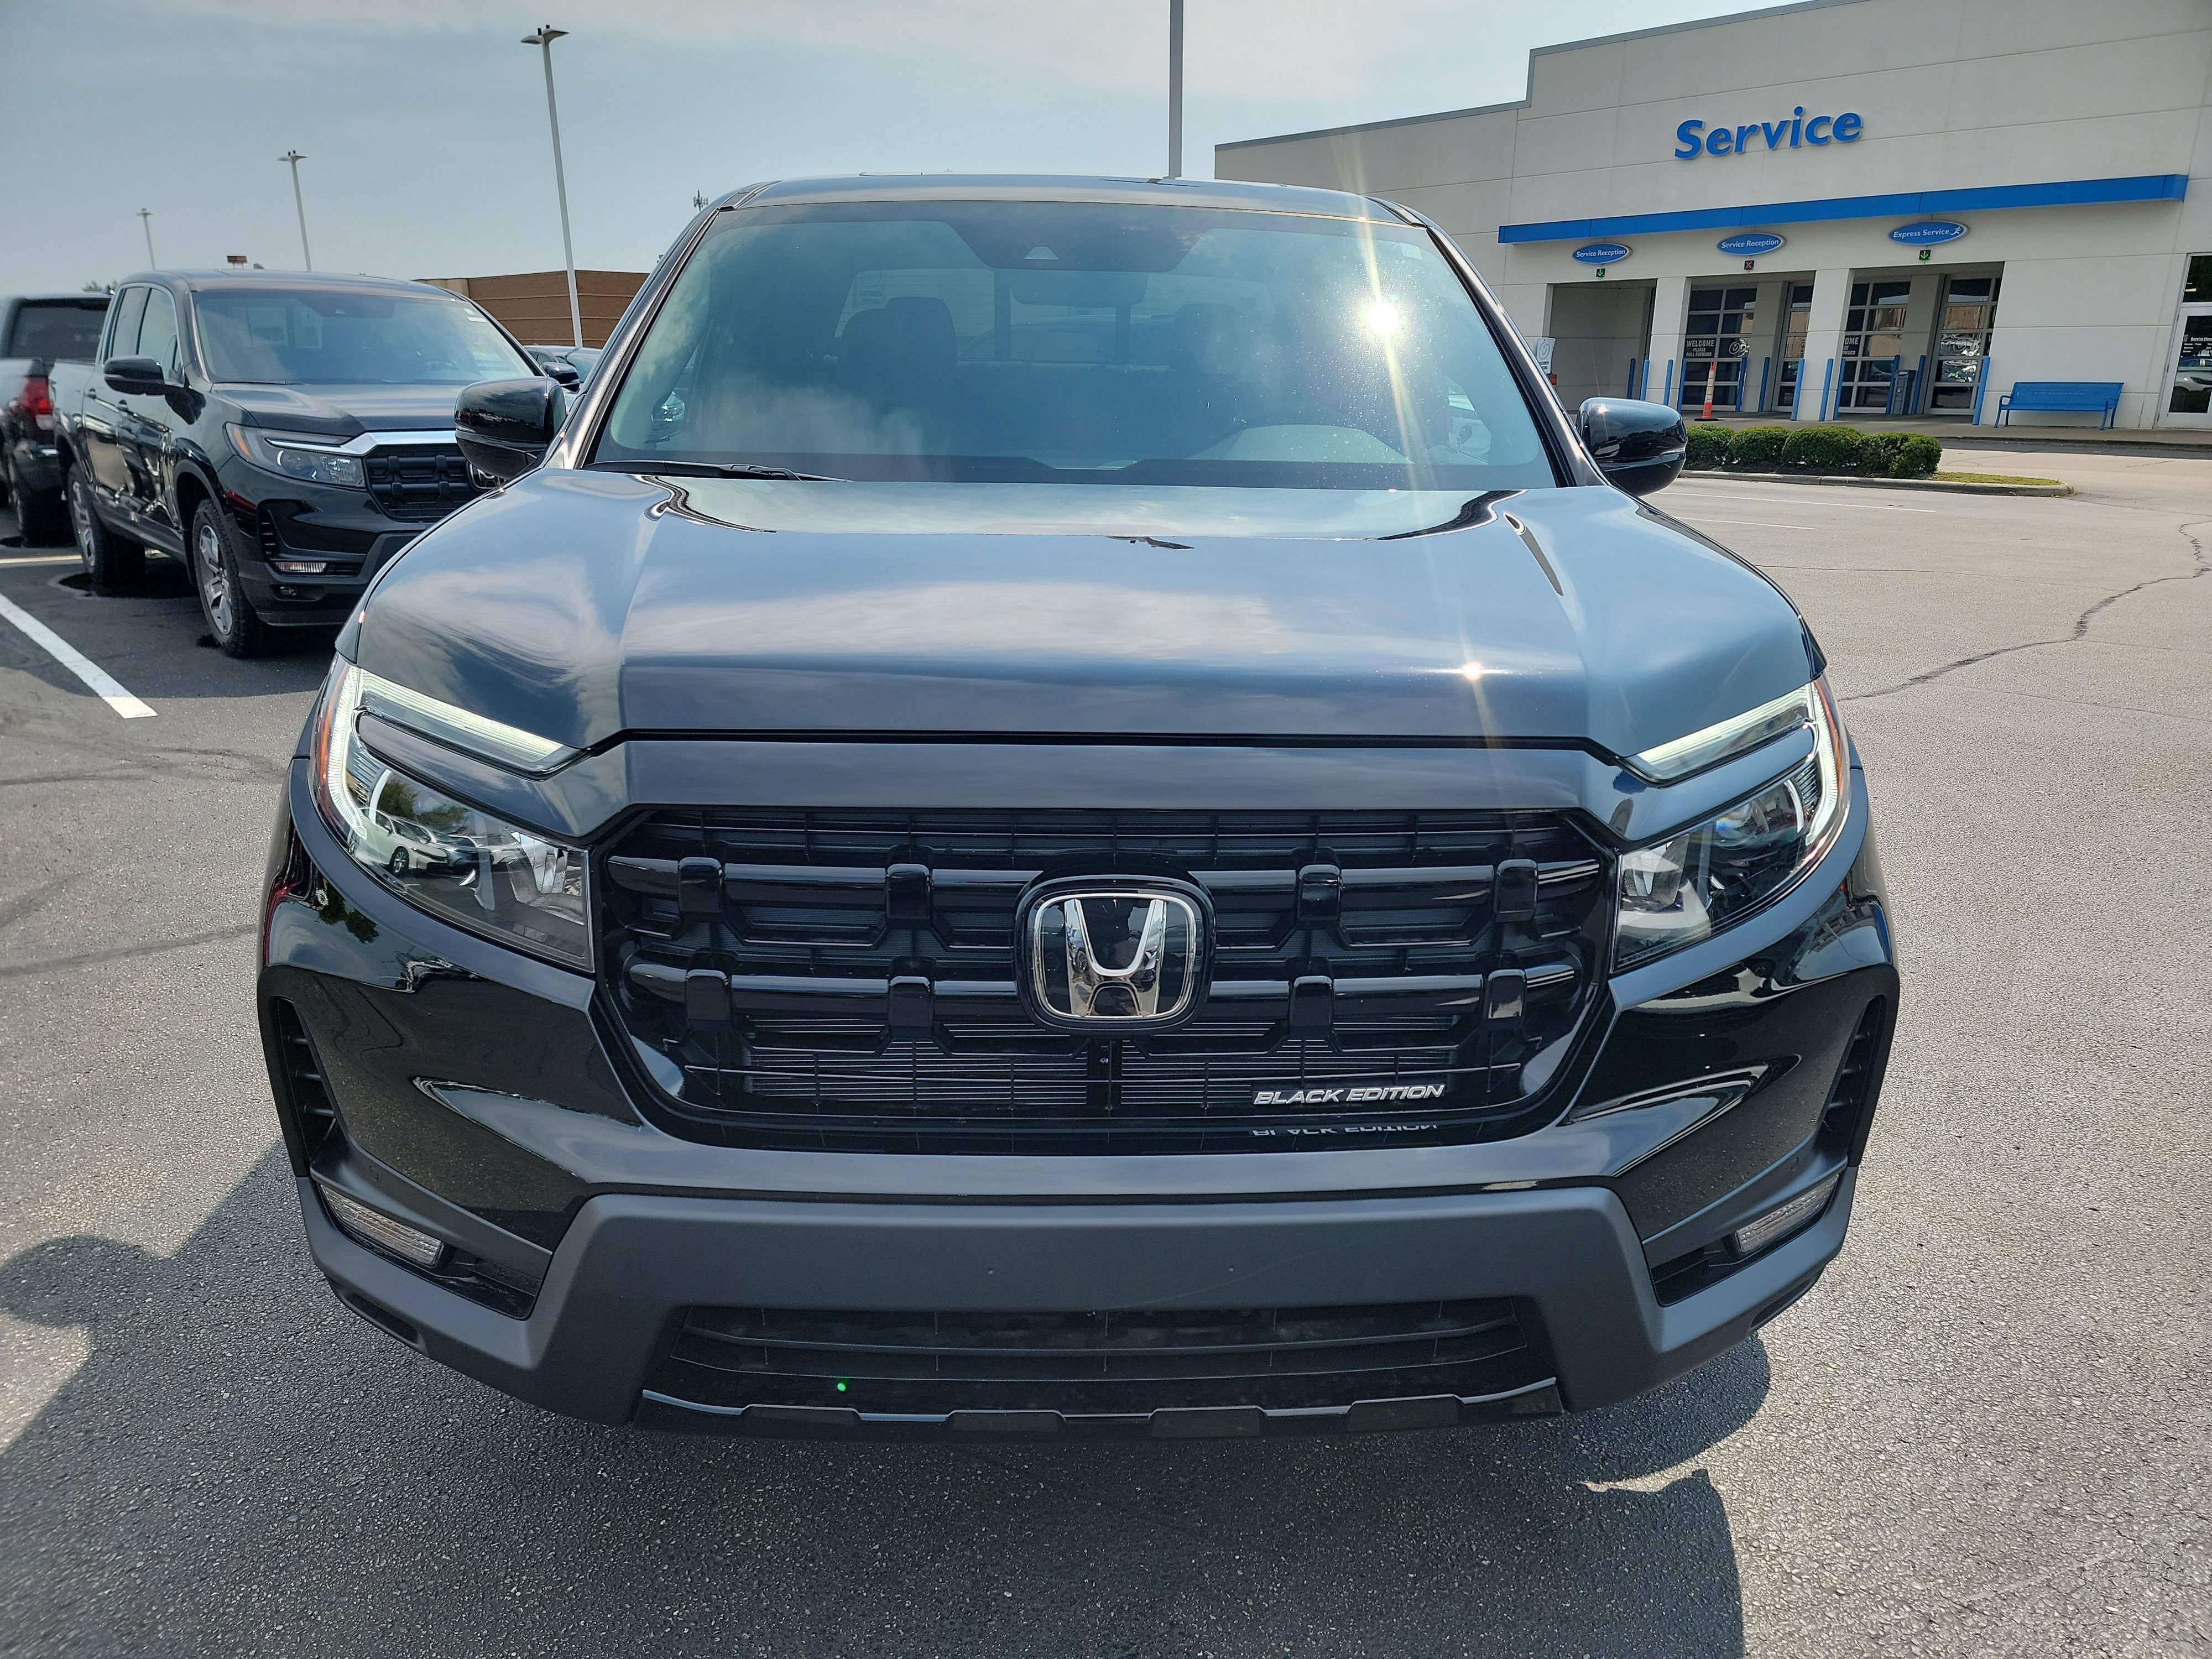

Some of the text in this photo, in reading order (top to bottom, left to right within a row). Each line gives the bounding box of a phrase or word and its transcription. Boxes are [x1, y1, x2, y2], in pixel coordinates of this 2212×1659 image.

[1674, 106, 1864, 160] Service
[1746, 239, 1779, 247] Reception
[1598, 248, 1626, 257] Reception
[1253, 1084, 1445, 1105] BLACK EDITION
